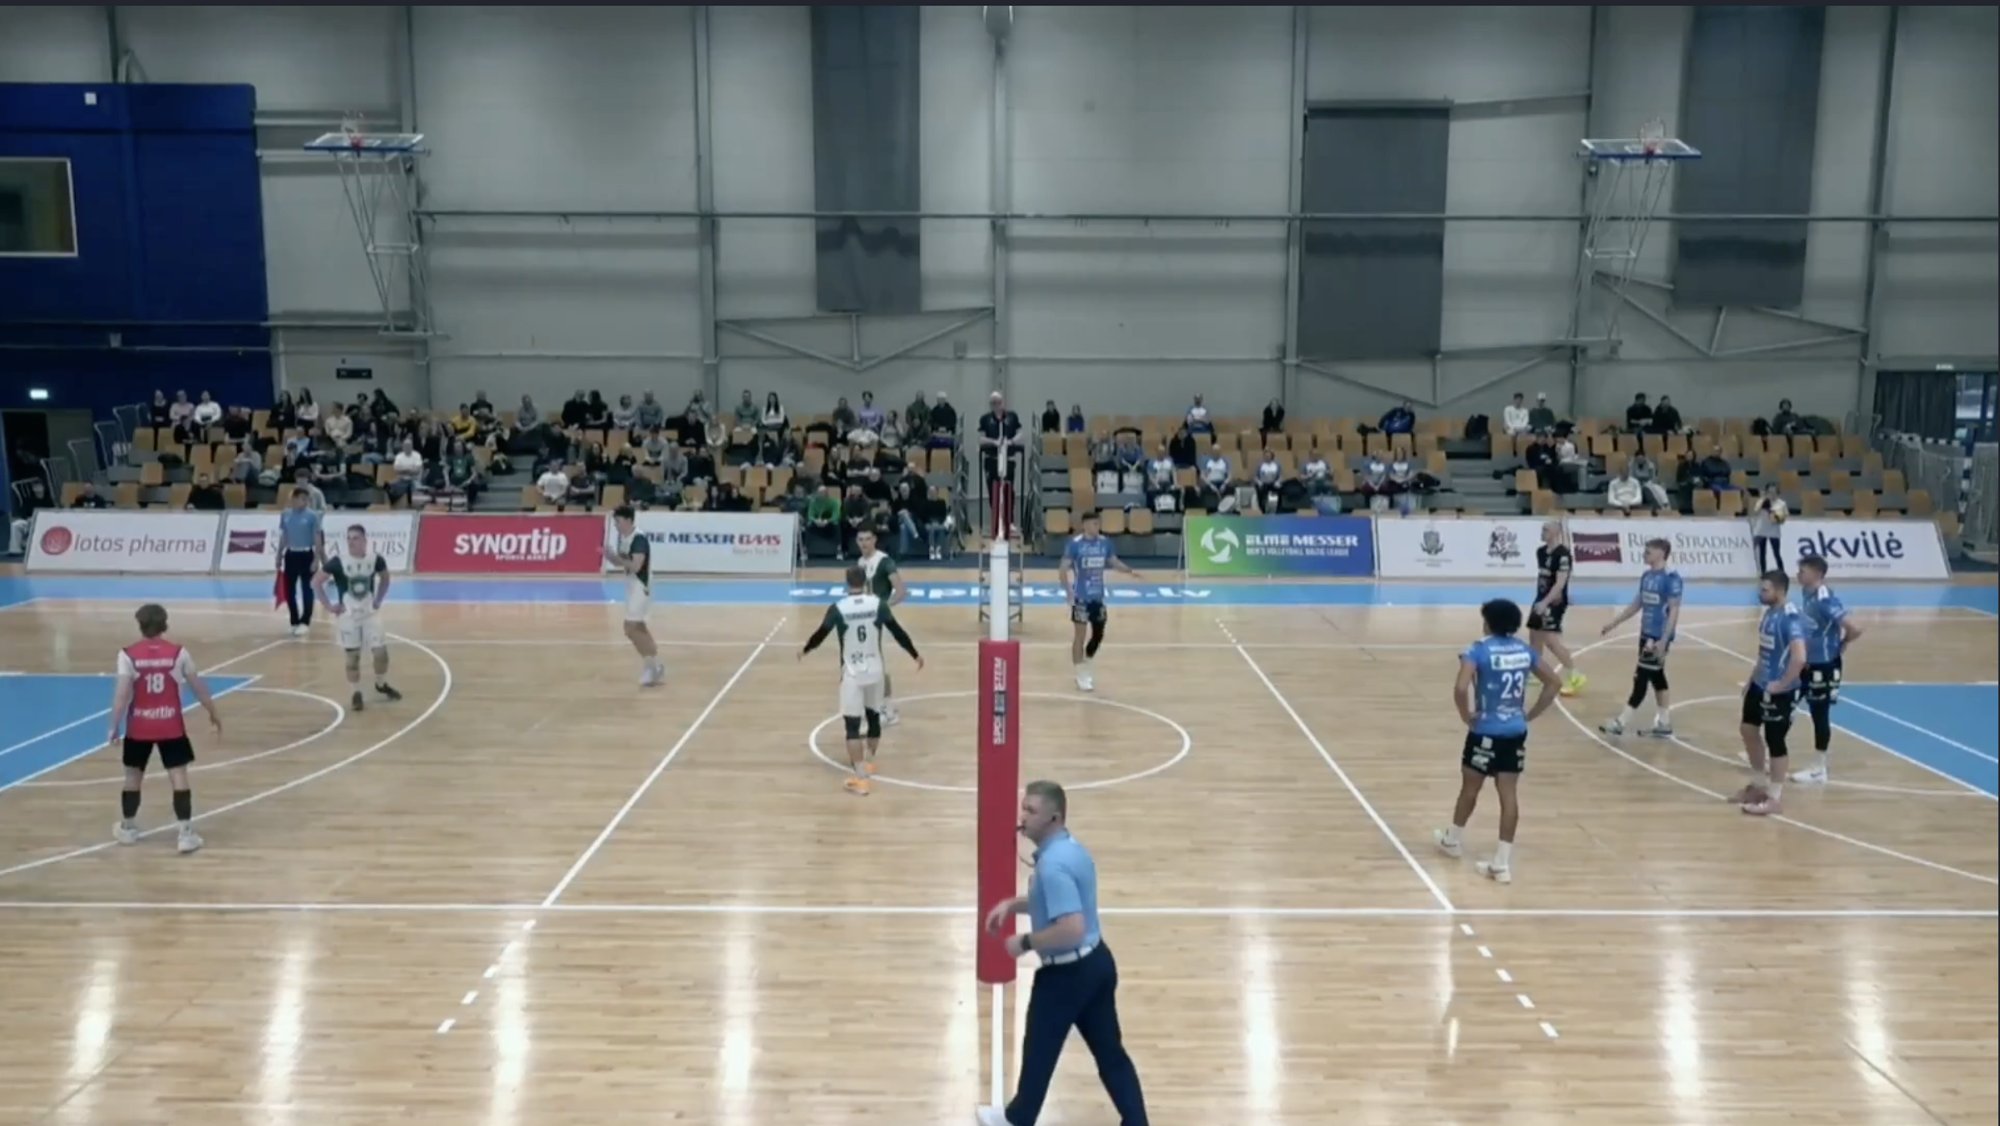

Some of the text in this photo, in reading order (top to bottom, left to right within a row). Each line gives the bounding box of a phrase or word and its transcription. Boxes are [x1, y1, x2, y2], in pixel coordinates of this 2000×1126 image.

[74, 534, 207, 556] lotos pharma
[668, 532, 735, 545] MESSER
[1293, 534, 1358, 547] MESSER
[1798, 530, 1904, 558] akvilė
[857, 625, 867, 643] 6
[145, 673, 165, 694] 18
[1501, 671, 1525, 699] 23
